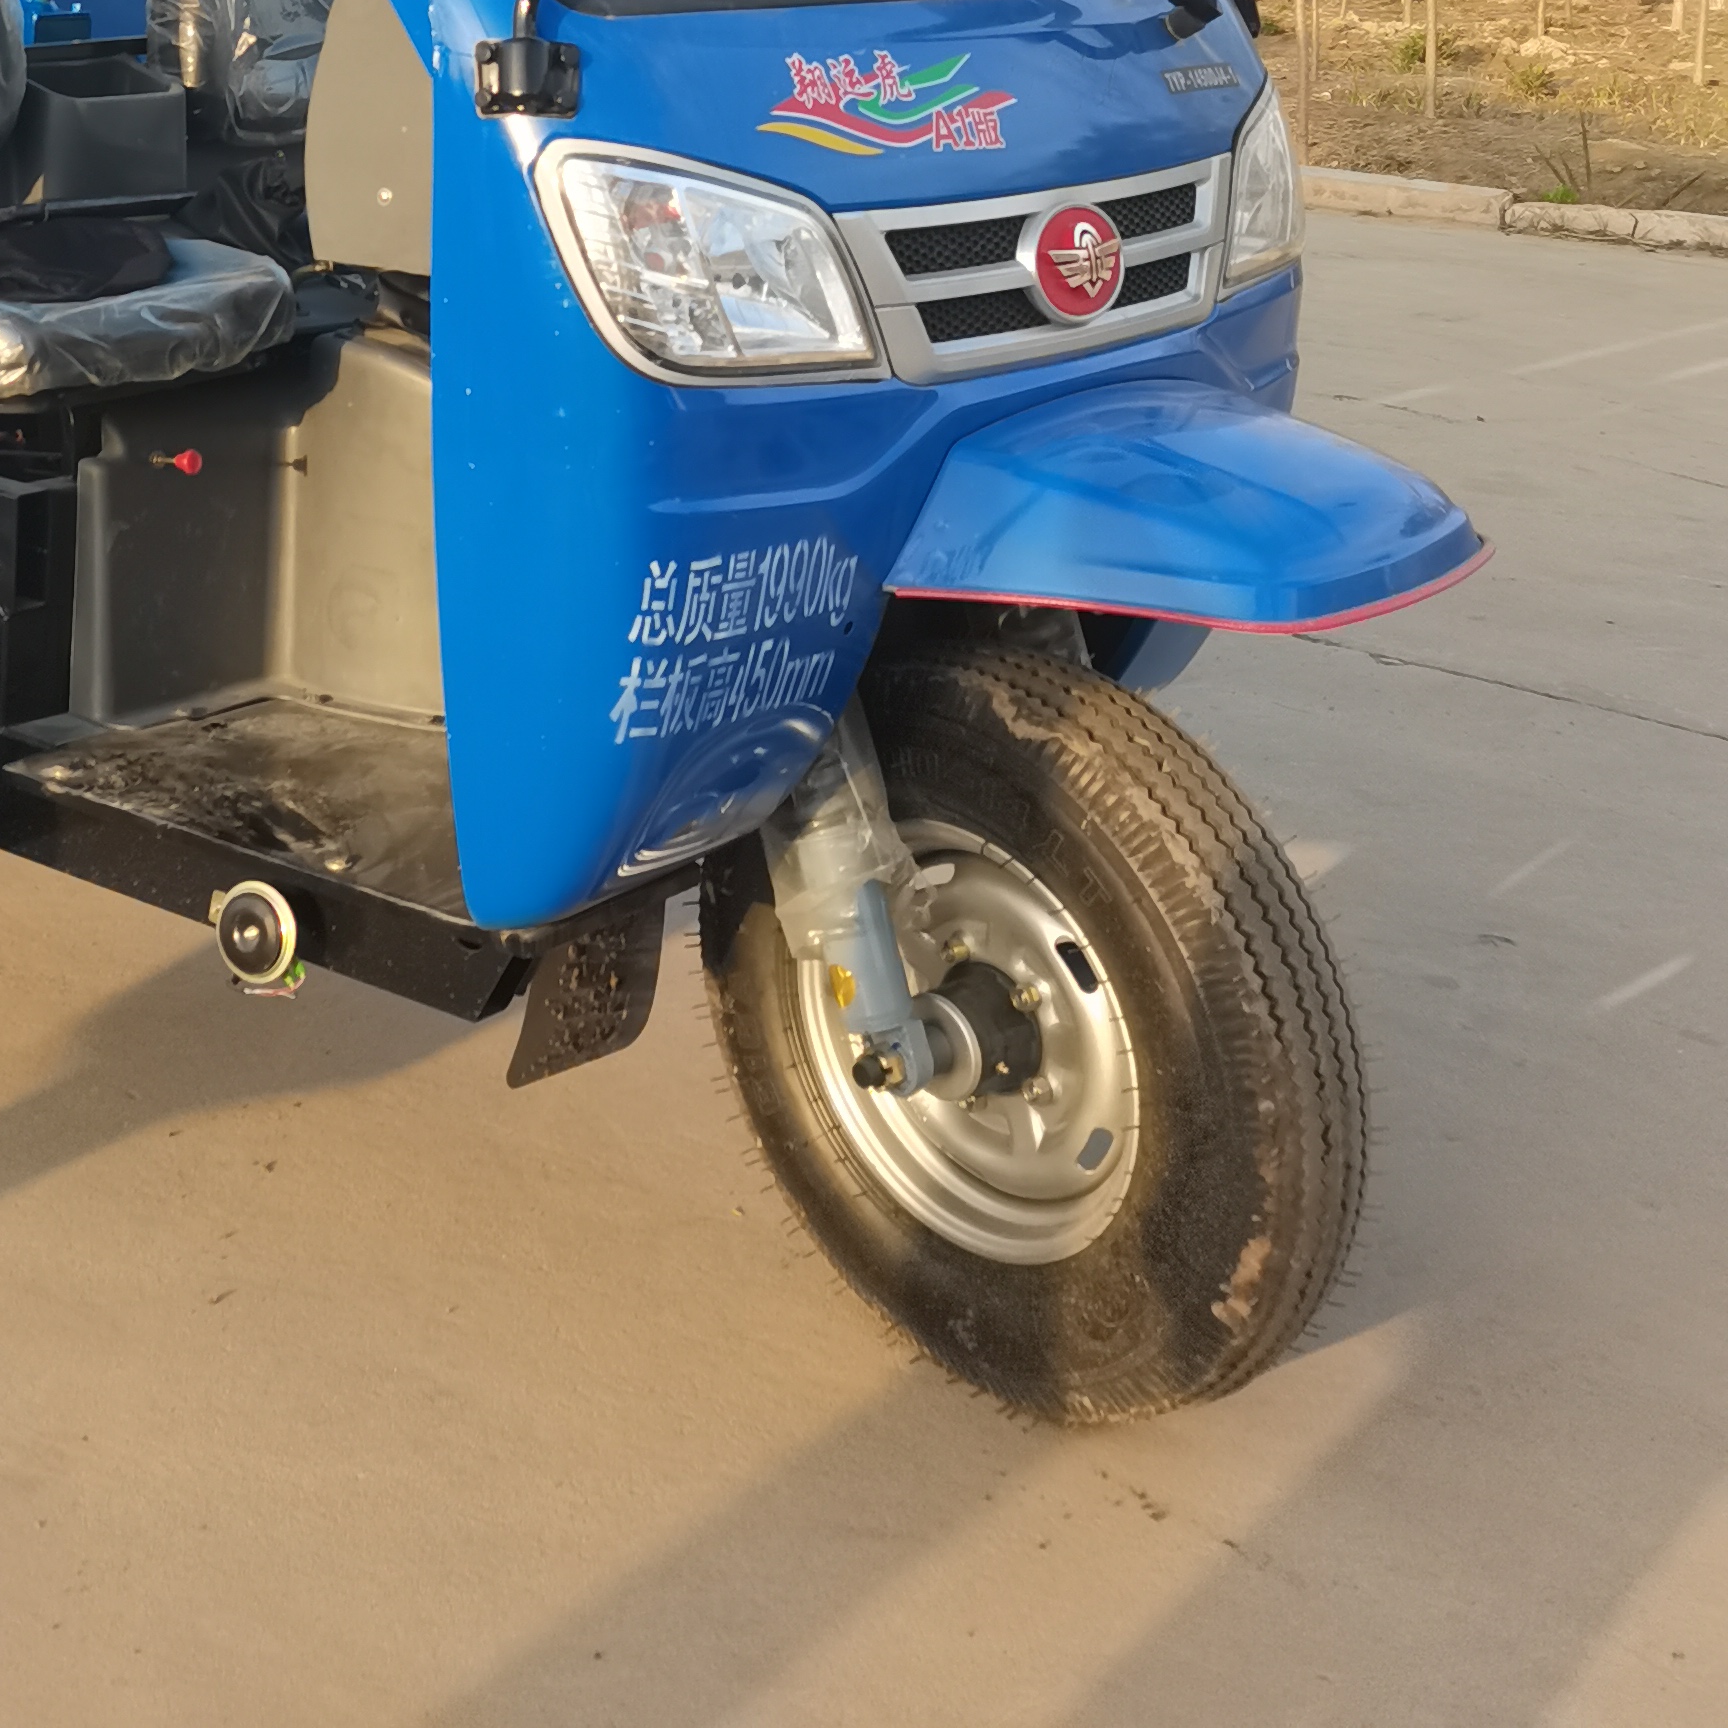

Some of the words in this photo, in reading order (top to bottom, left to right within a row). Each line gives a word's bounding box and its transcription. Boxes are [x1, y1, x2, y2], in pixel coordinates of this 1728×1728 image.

[785, 50, 917, 110] 翔运虎
[932, 108, 1007, 152] A1版
[627, 536, 859, 647] 总质量1990kg
[609, 636, 836, 745] 栏板高450mm
